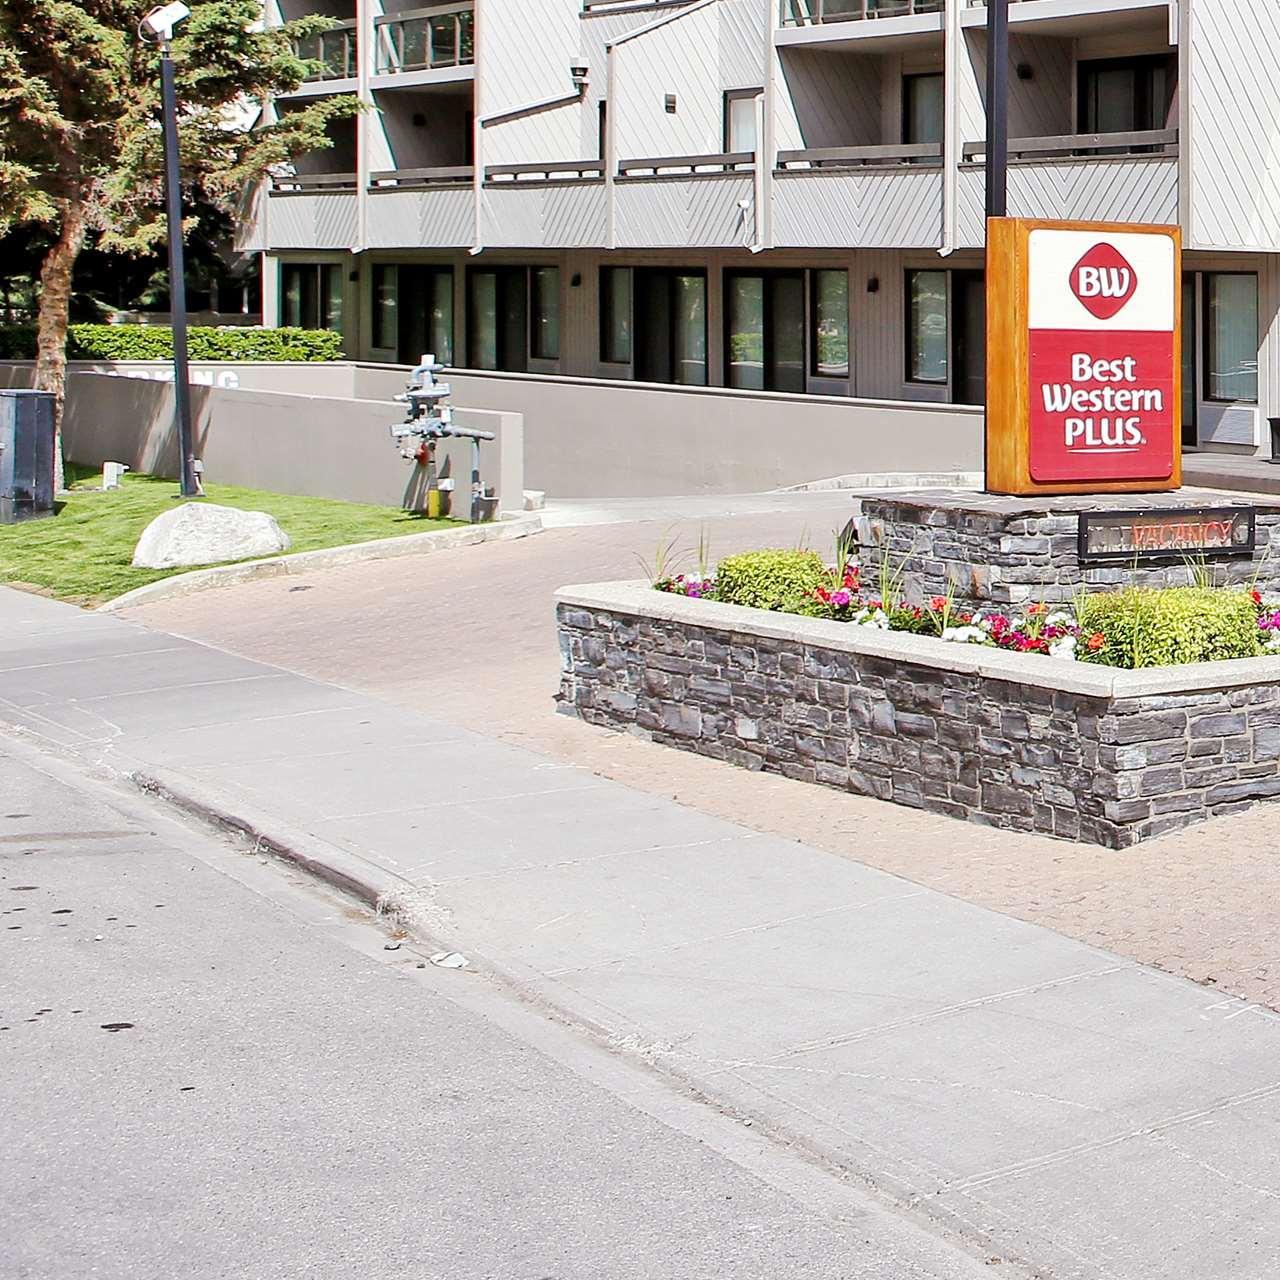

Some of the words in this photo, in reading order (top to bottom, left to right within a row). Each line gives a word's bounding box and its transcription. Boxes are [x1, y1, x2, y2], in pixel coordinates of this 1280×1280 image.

[1078, 266, 1131, 298] BW
[1071, 352, 1137, 383] Best
[1041, 383, 1164, 414] Western
[1064, 417, 1142, 447] PLUS
[1131, 521, 1232, 545] VACANCY
